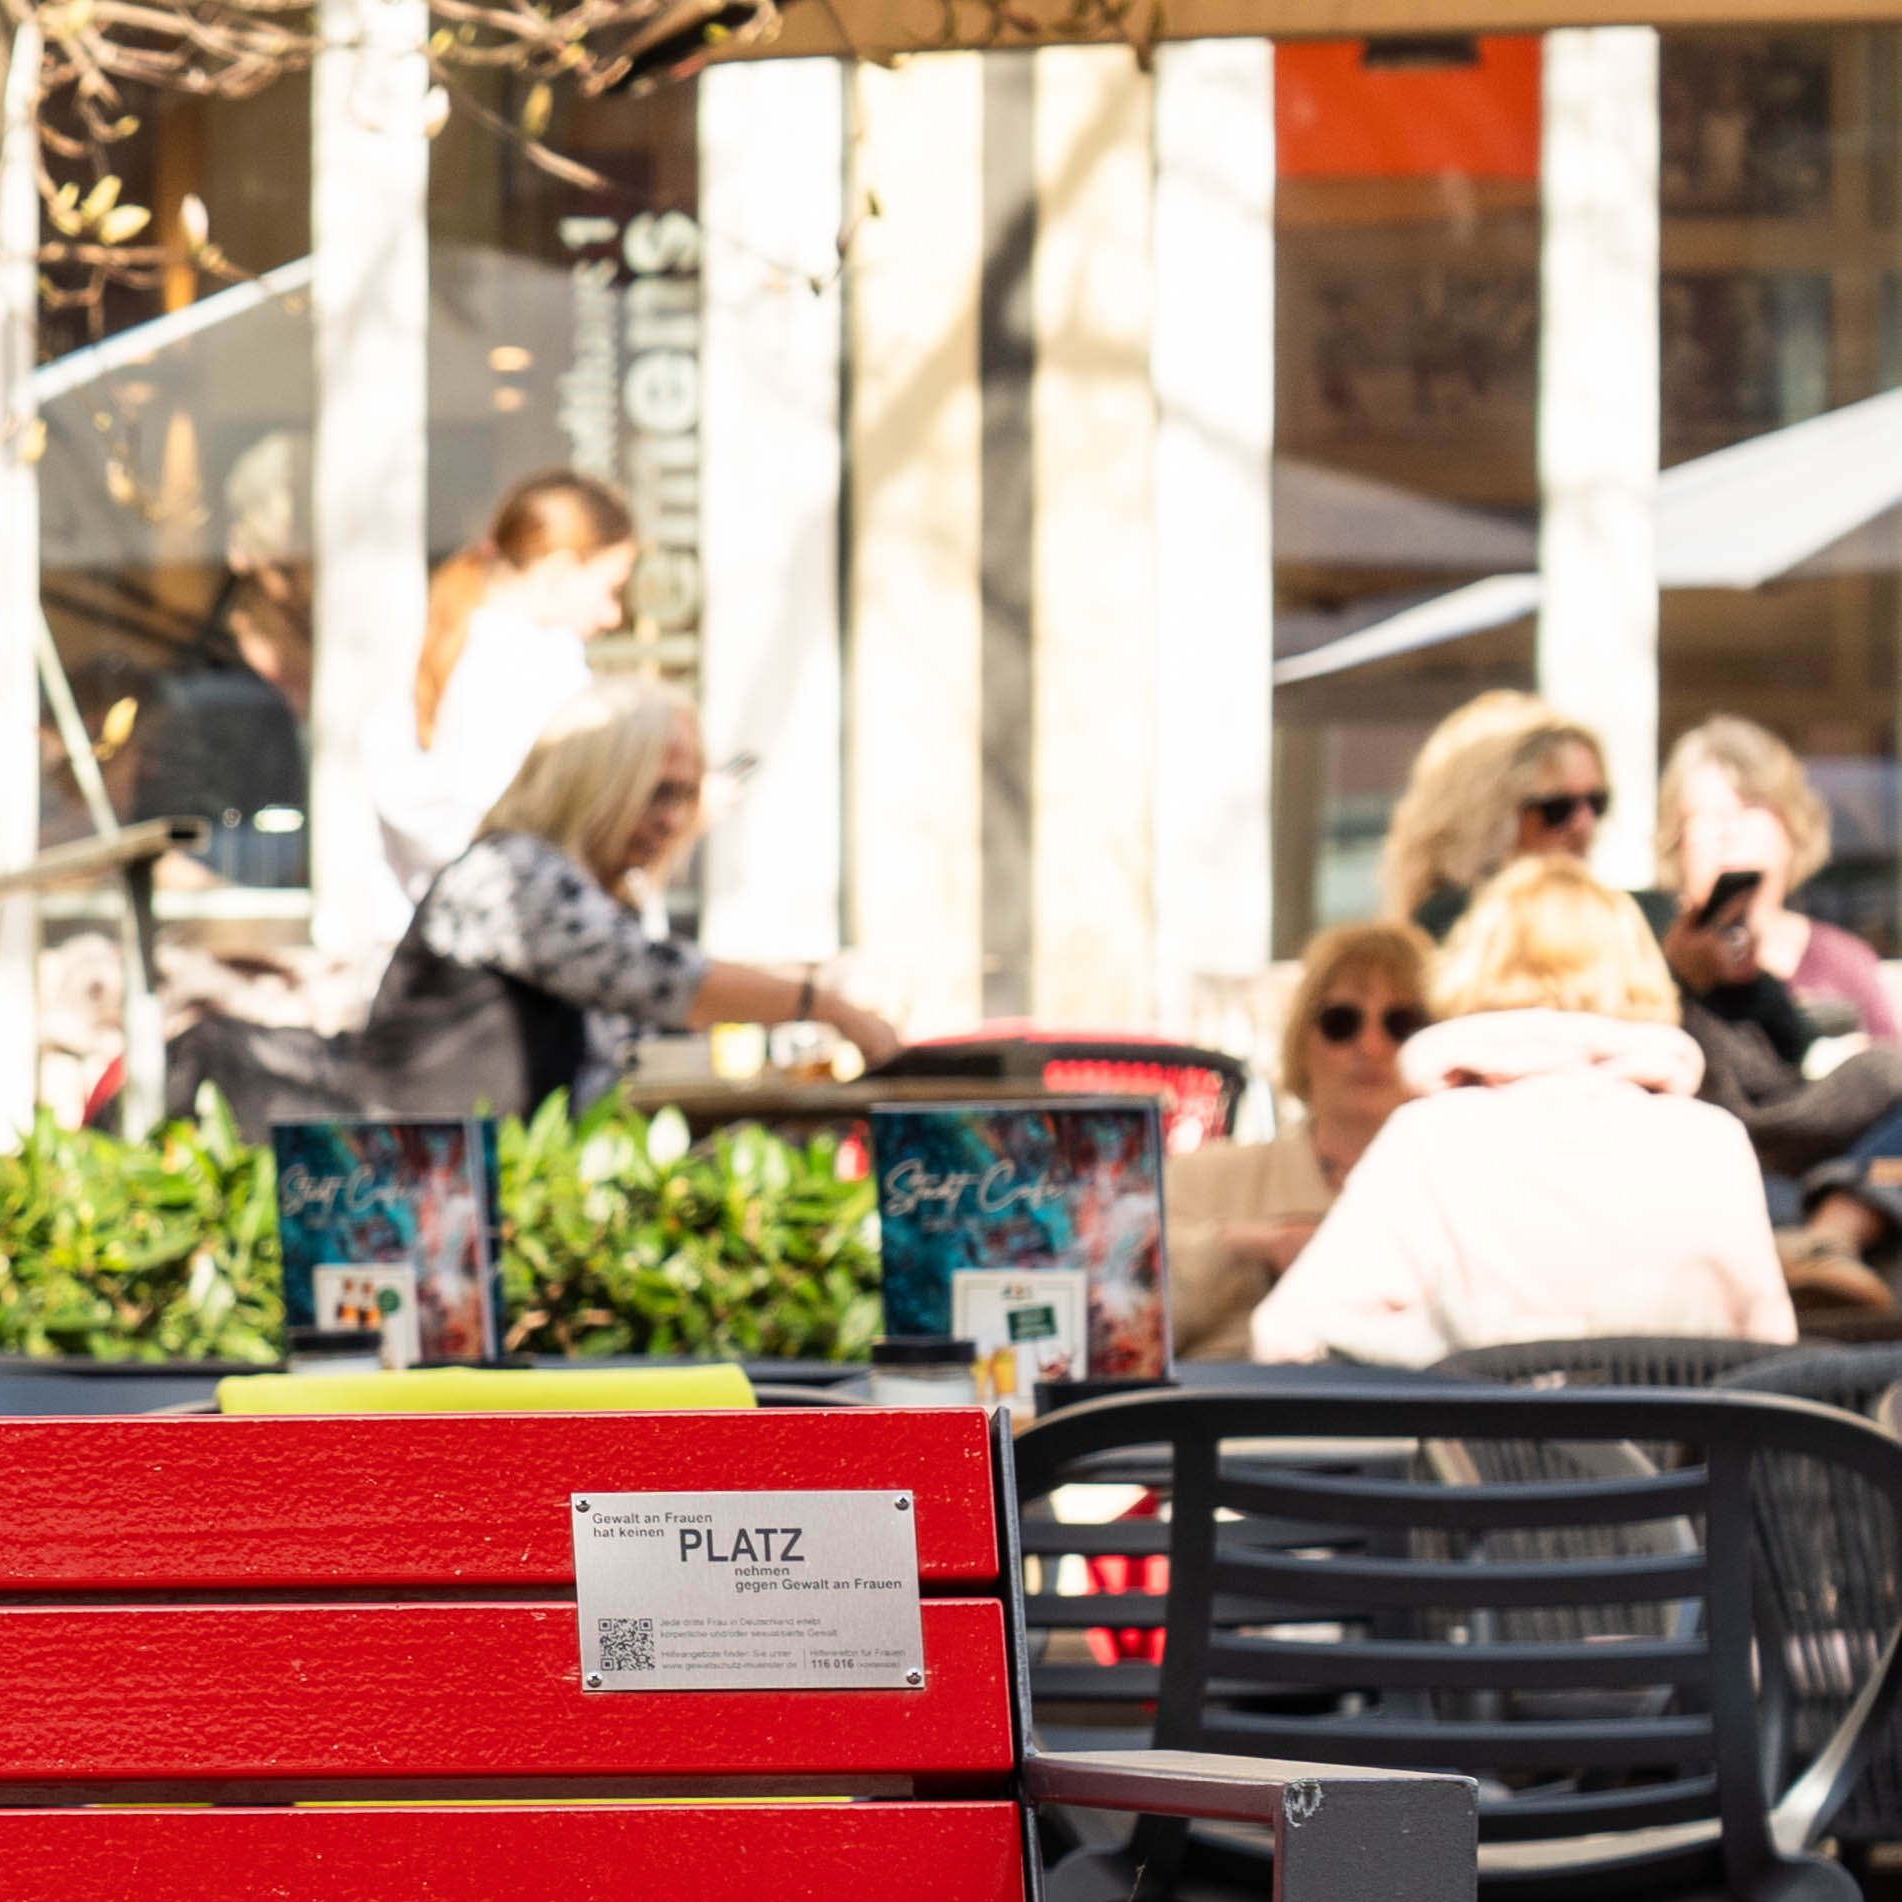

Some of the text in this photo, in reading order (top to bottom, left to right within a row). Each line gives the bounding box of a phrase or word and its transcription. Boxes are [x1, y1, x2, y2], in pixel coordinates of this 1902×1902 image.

[592, 1511, 713, 1524] Gewalt an Frauen
[593, 1527, 665, 1538] hat keinen
[679, 1527, 805, 1562] PLATZ
[734, 1566, 790, 1577] nehmen
[735, 1578, 902, 1593] gegen Gewalt an Frauen
[812, 1659, 831, 1669] 116
[833, 1659, 855, 1669] 016
